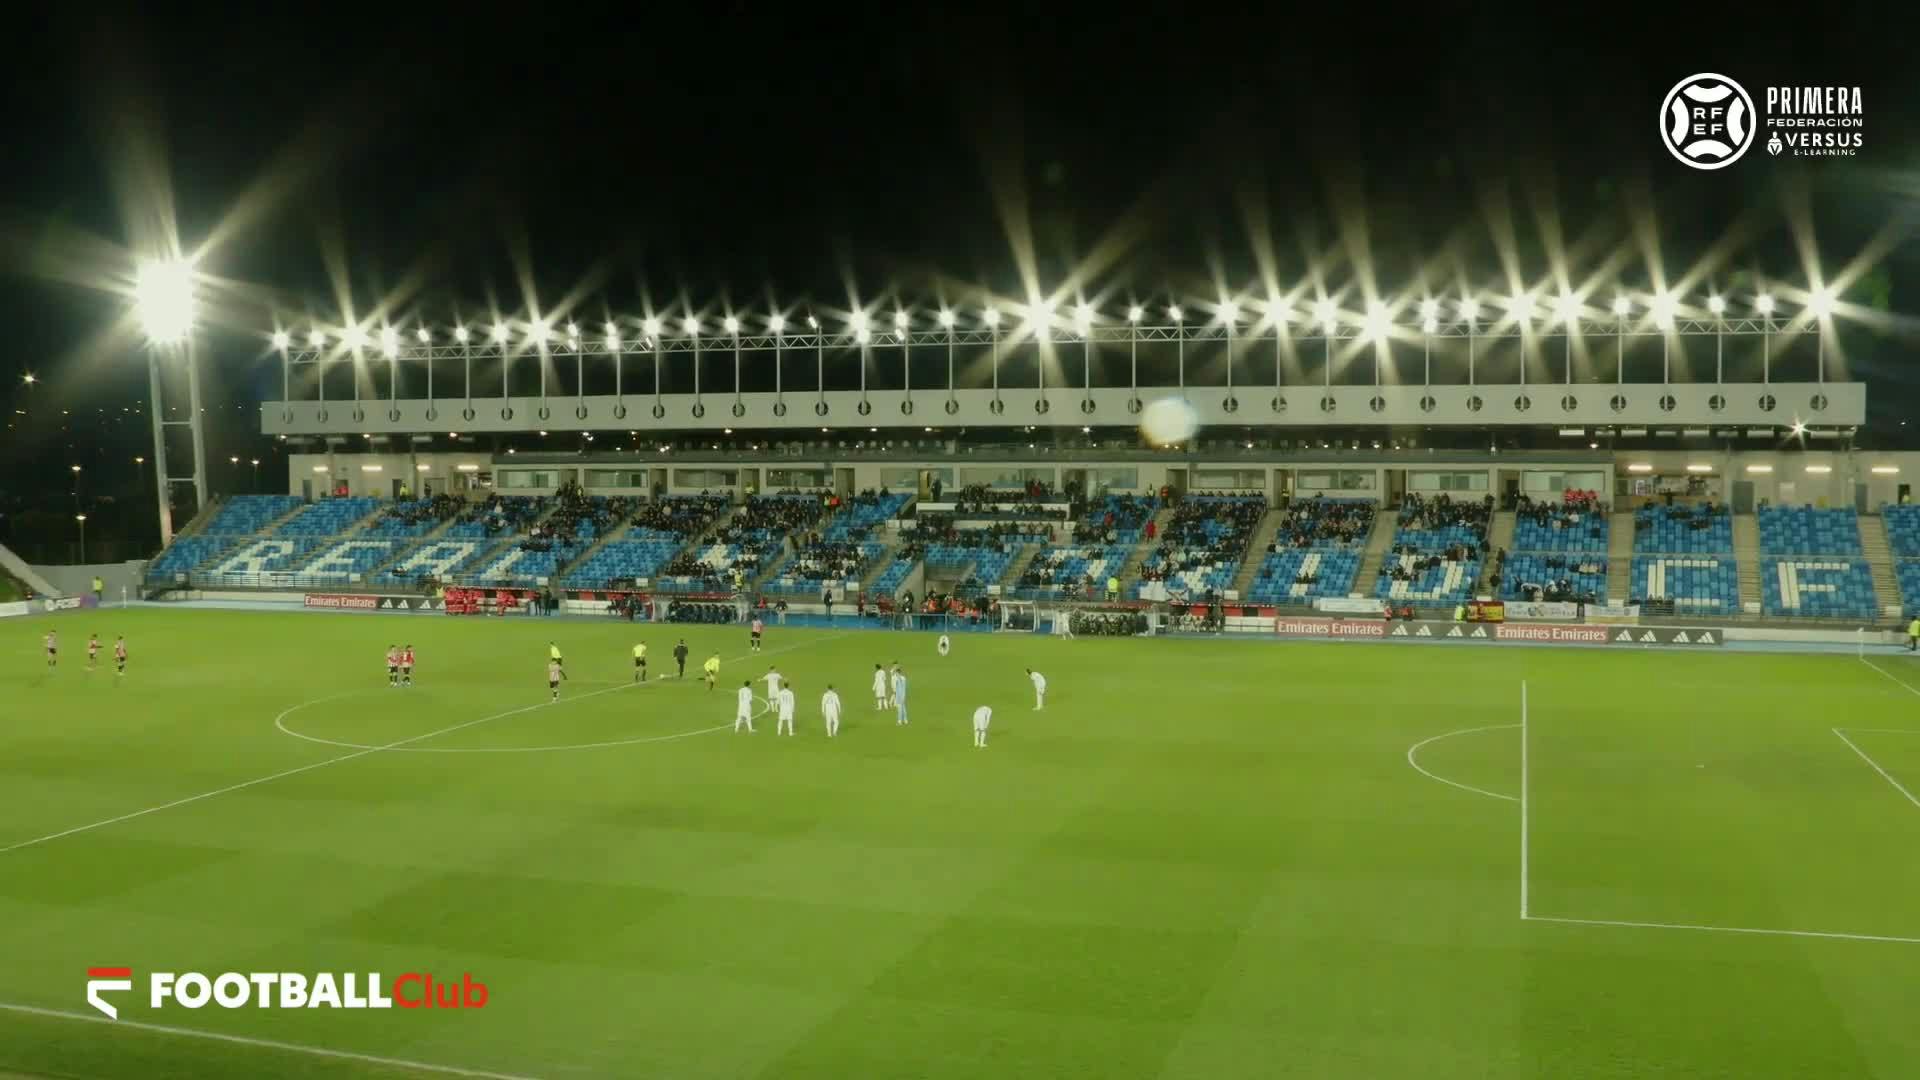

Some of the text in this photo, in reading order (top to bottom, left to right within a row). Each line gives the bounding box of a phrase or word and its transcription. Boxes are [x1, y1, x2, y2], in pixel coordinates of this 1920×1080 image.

[305, 596, 377, 608] Emirates Emirates
[1278, 620, 1384, 635] Emirates Emirates
[1497, 626, 1606, 641] Emirates Emirates
